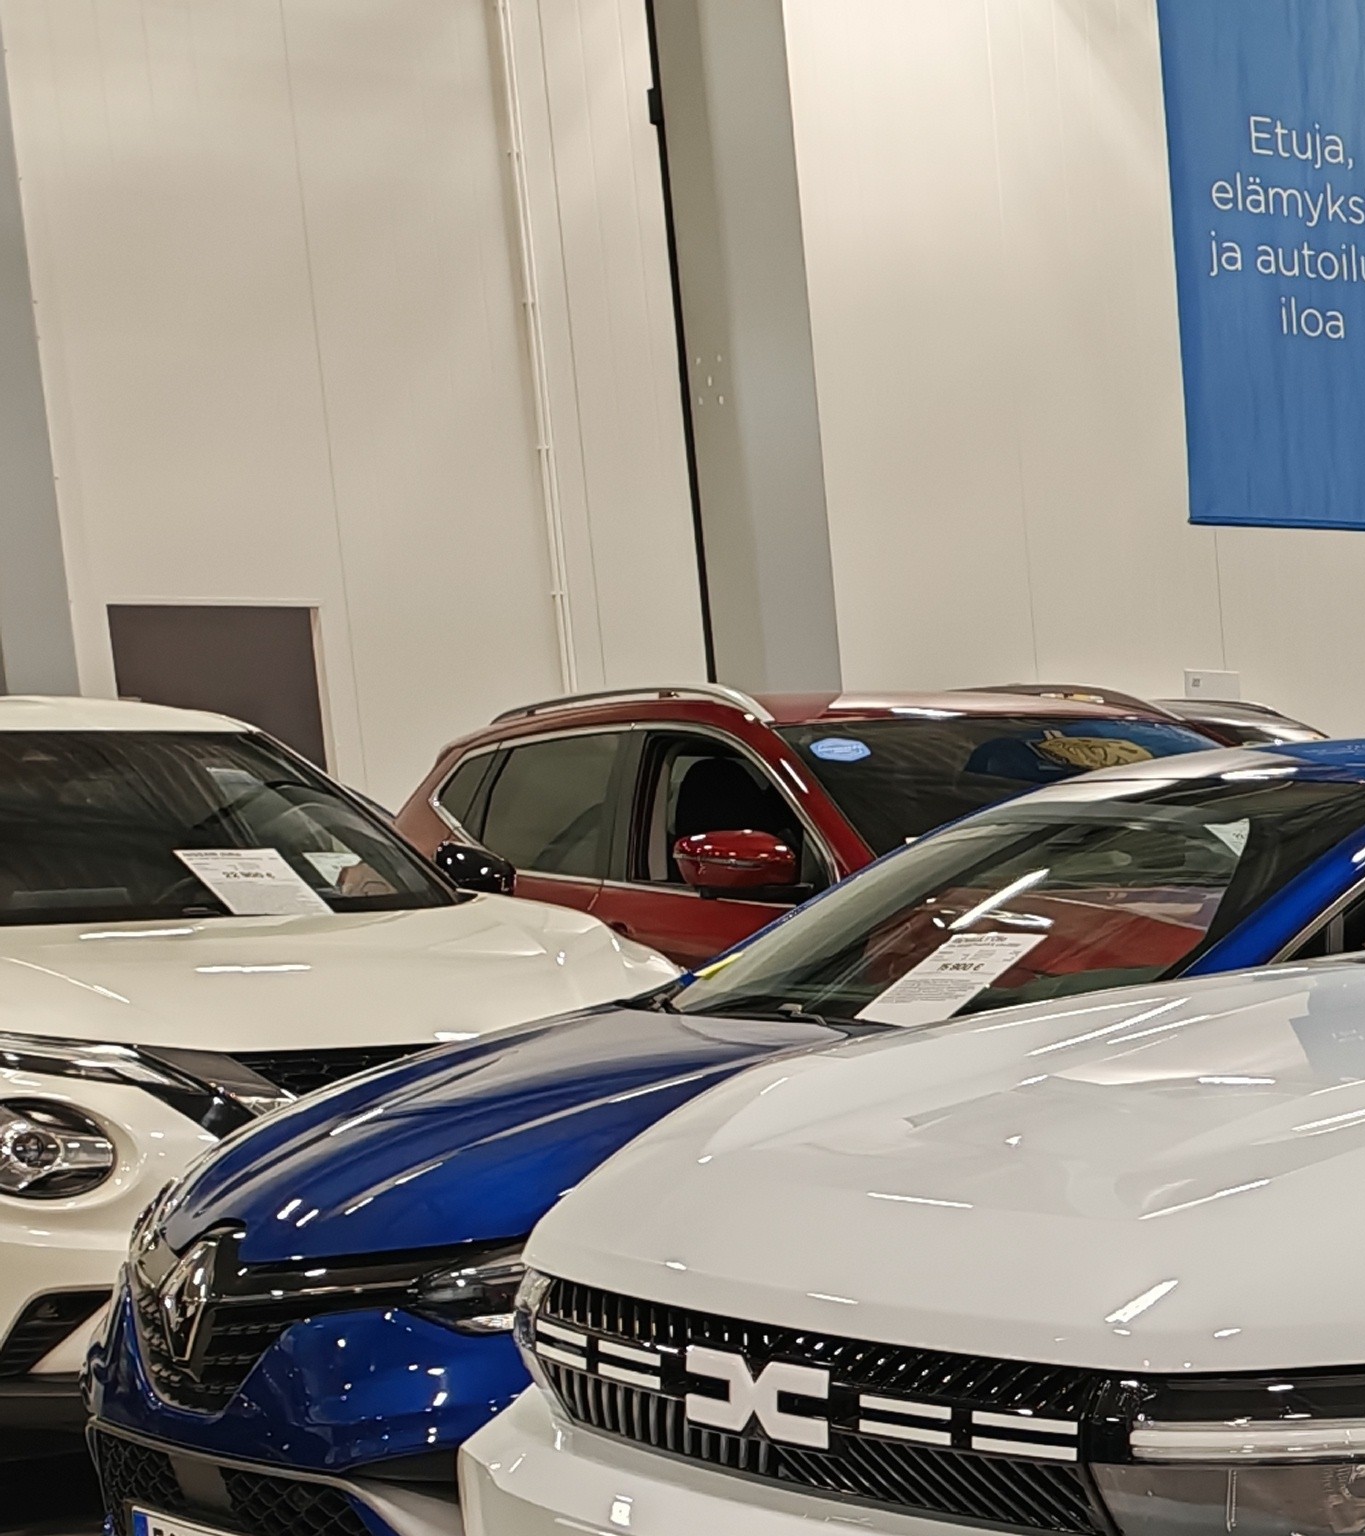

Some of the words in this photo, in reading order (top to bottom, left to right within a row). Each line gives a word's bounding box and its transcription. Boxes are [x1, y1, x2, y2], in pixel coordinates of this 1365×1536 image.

[1249, 115, 1355, 170] Etuja,
[1209, 231, 1242, 277] ja
[1280, 296, 1346, 340] iloa
